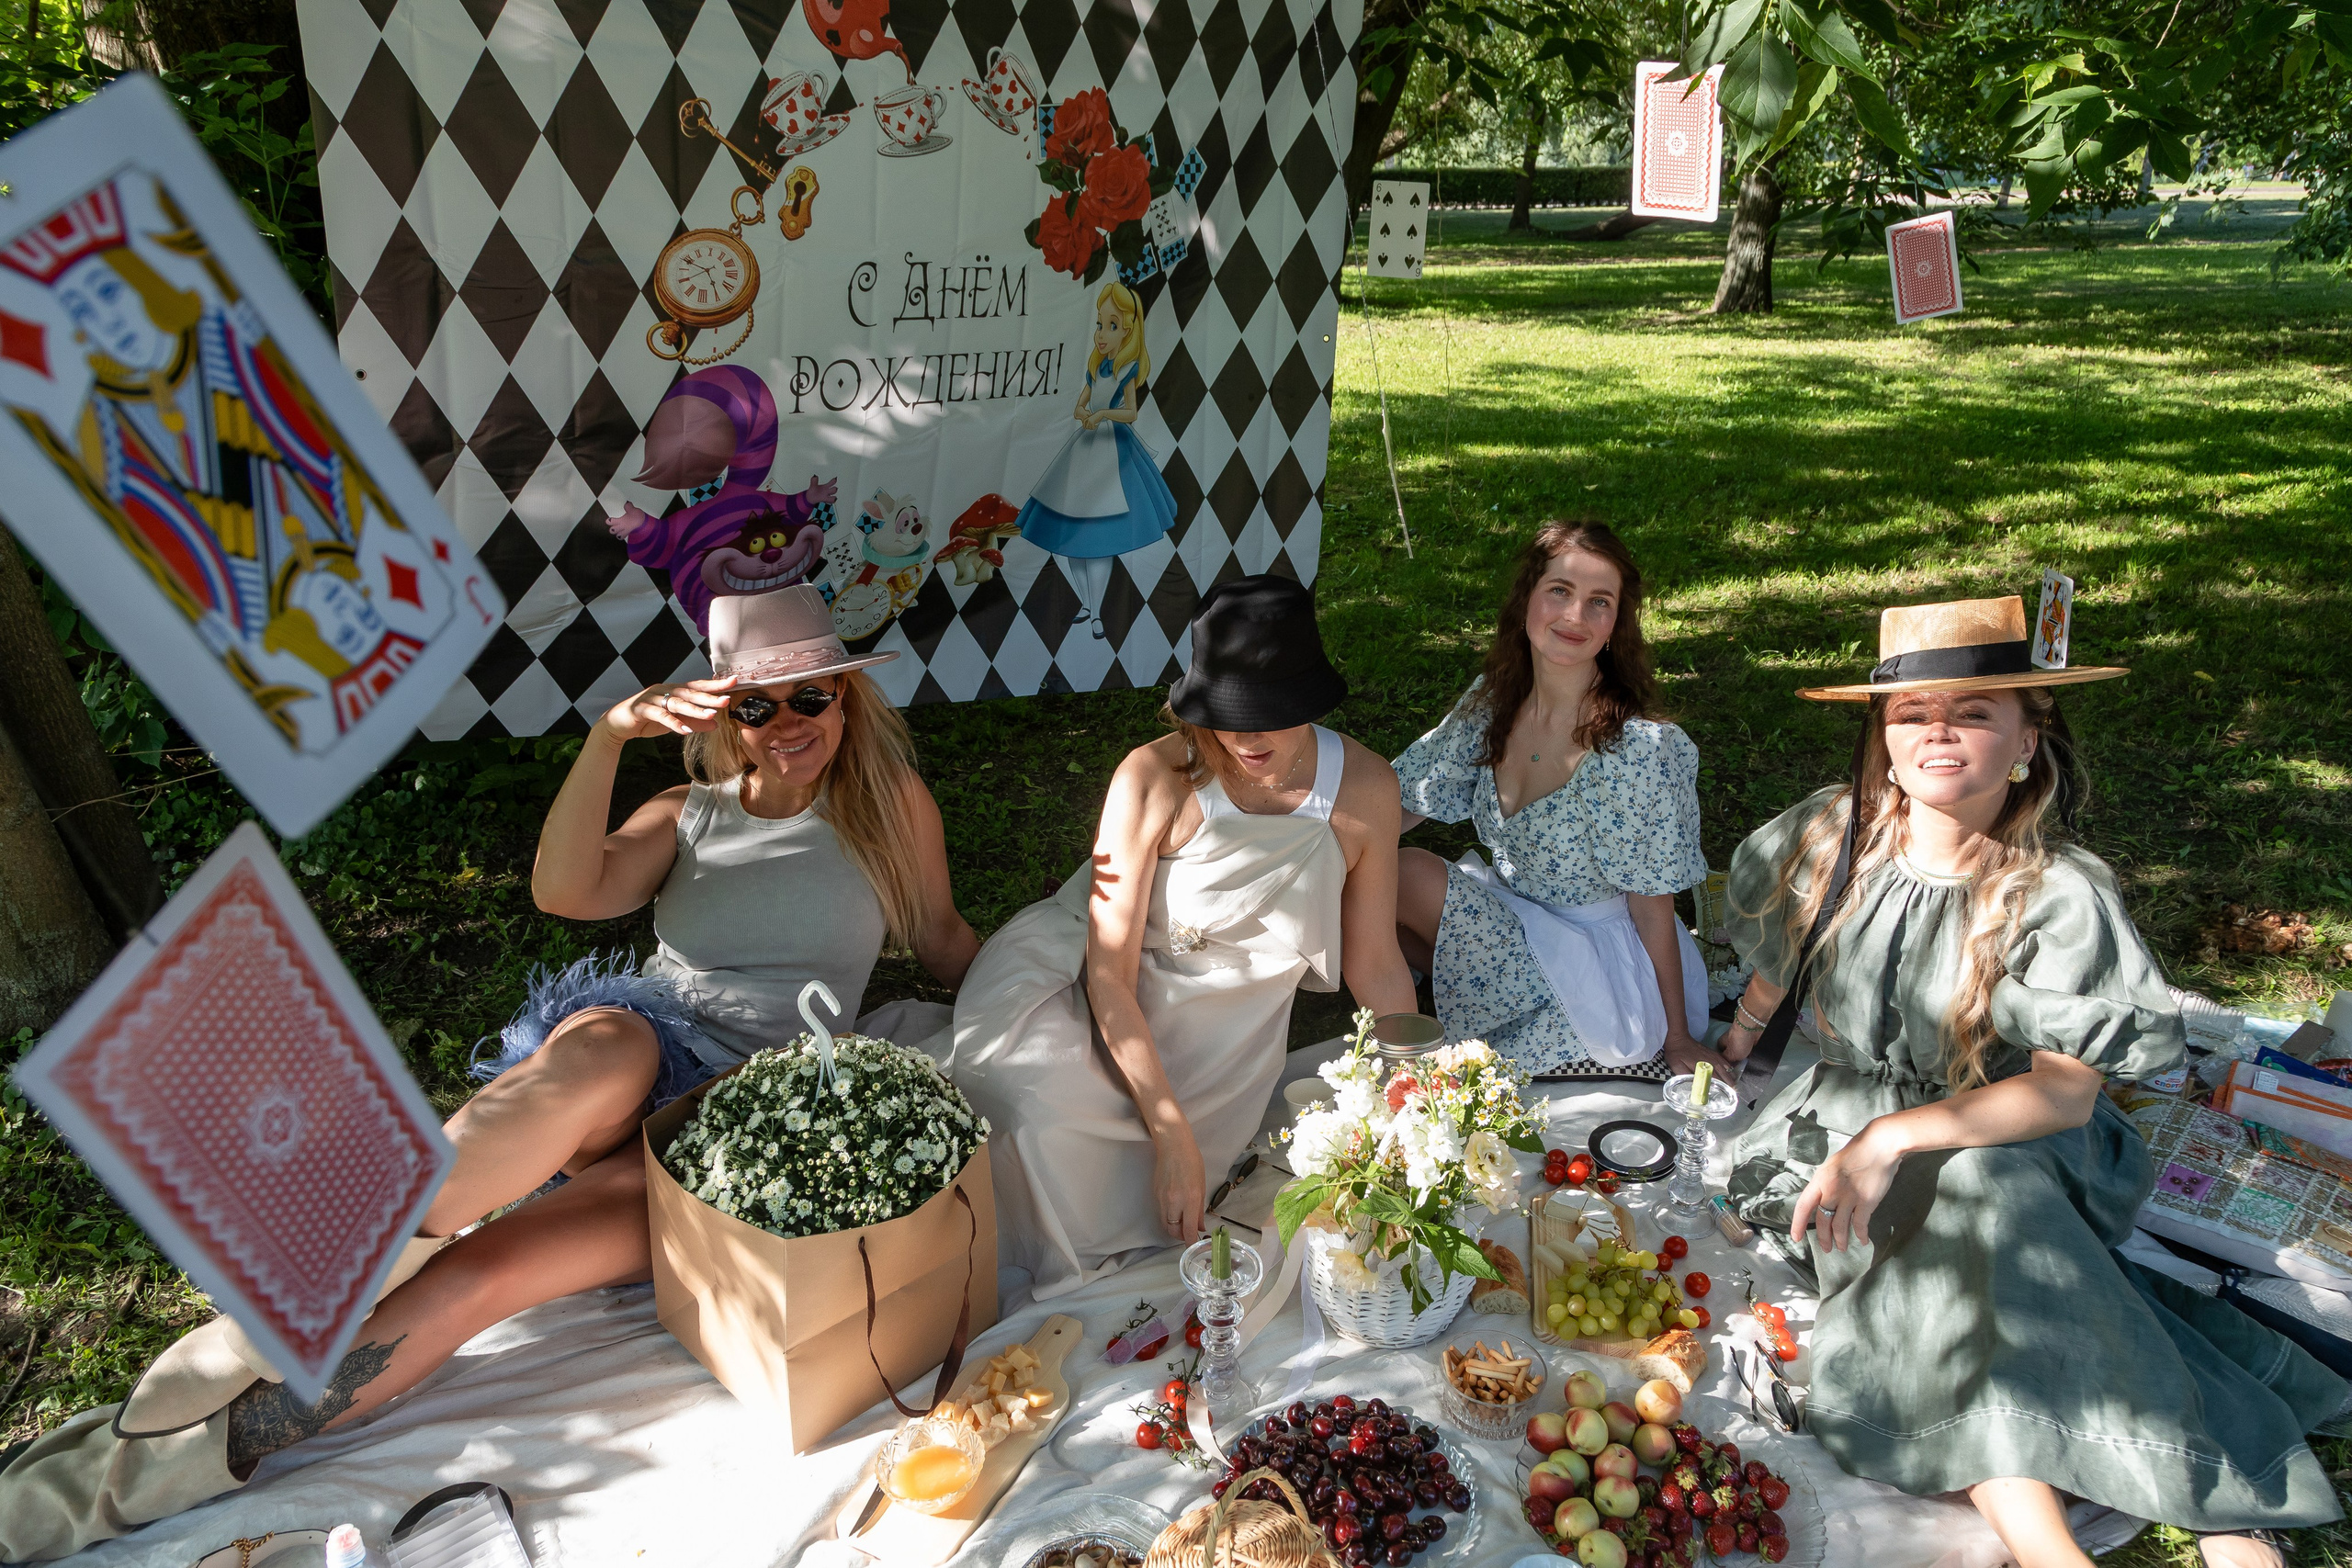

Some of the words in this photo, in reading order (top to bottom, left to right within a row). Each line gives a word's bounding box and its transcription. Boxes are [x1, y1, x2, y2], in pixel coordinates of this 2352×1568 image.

[1375, 183, 1382, 193] 6
[1415, 267, 1421, 277] 6
[847, 261, 877, 328] С
[892, 252, 1029, 333] ДНЁМ
[788, 343, 1065, 414] РОЖДЕНИЯ!
